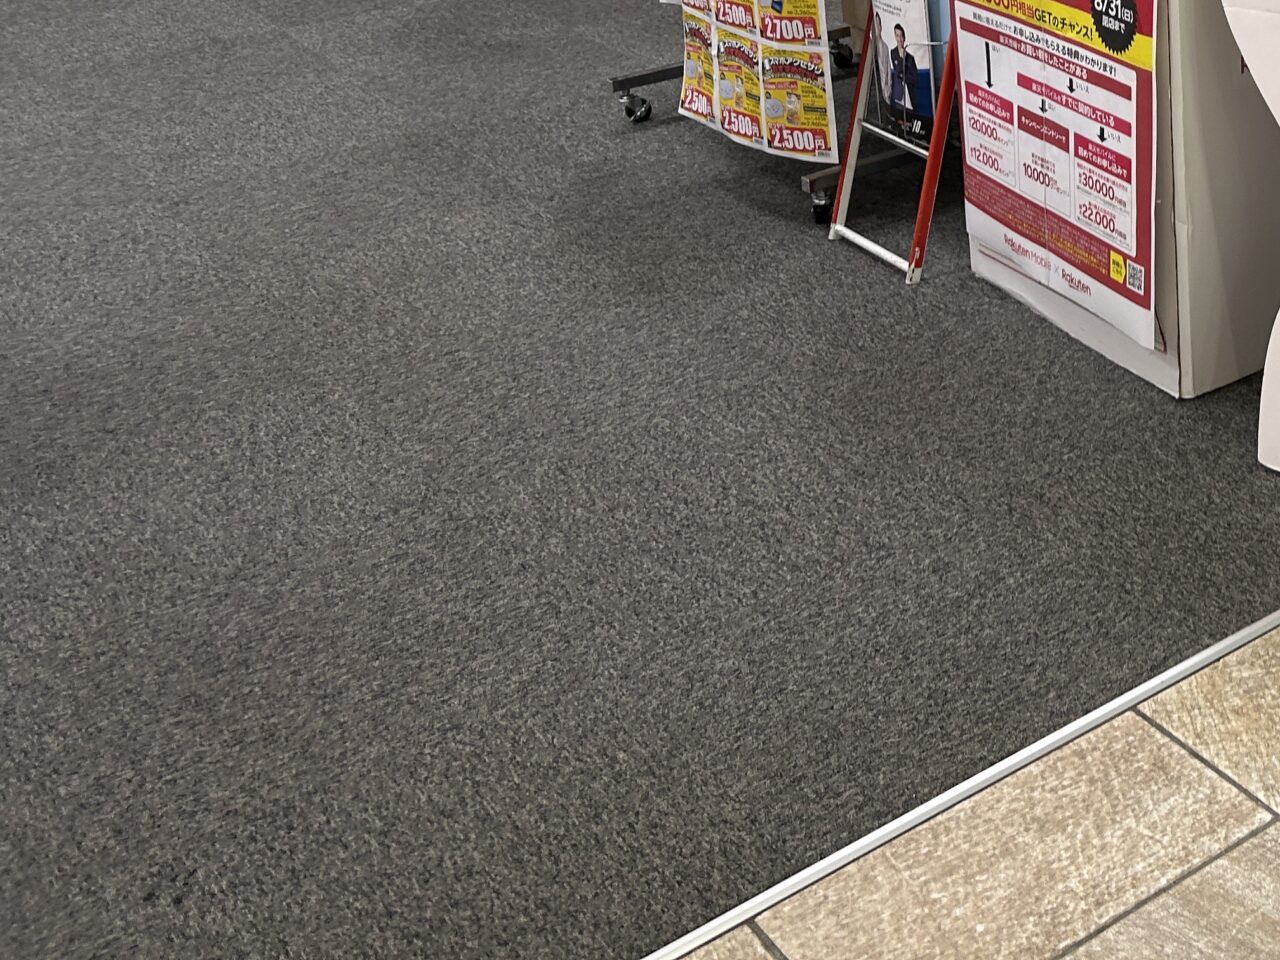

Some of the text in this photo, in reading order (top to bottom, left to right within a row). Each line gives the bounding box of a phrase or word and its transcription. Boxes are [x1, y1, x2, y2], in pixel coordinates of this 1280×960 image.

[765, 19, 814, 40] 2,700円
[1004, 234, 1031, 259] Rakuten
[1061, 269, 1092, 296] Rakuten
